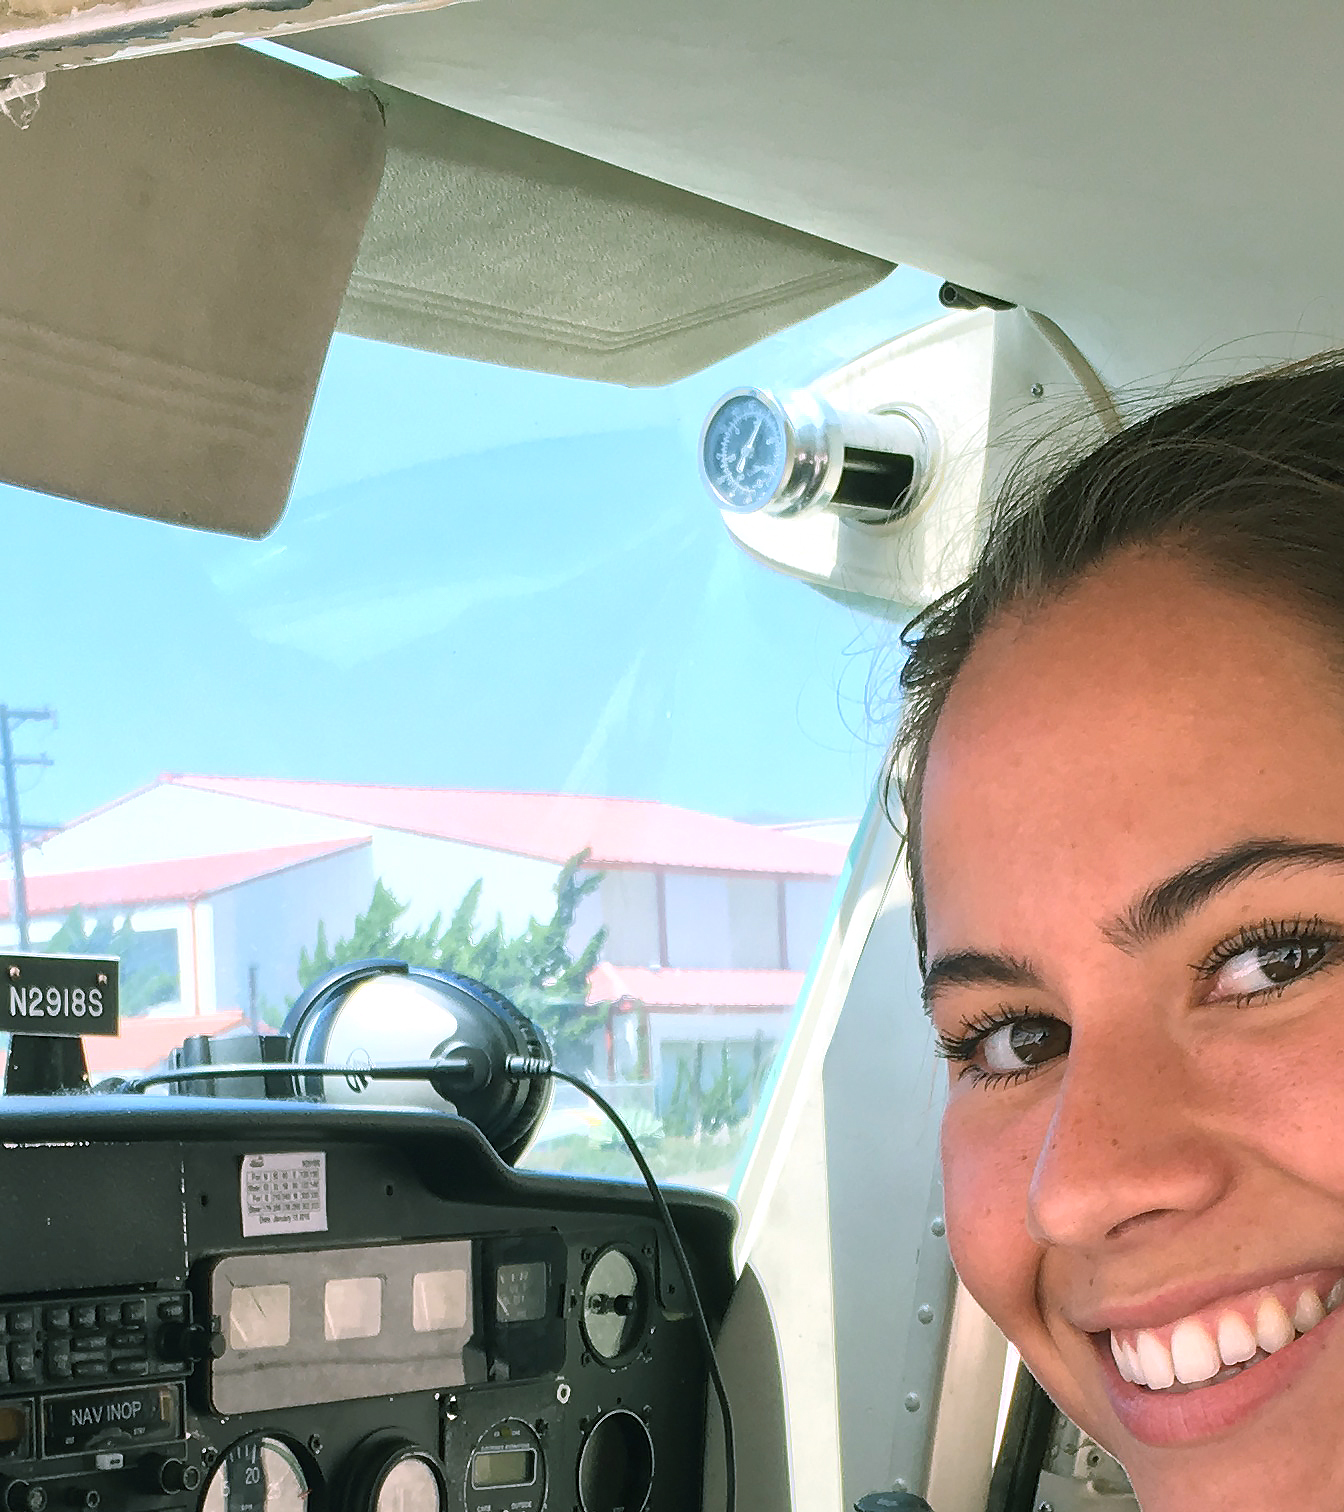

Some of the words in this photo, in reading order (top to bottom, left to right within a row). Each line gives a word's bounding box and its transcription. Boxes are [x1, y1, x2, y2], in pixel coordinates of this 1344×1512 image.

[9, 986, 104, 1018] N2918S
[70, 1405, 103, 1427] NAV
[105, 1399, 142, 1423] INOP
[244, 1465, 261, 1486] 20
